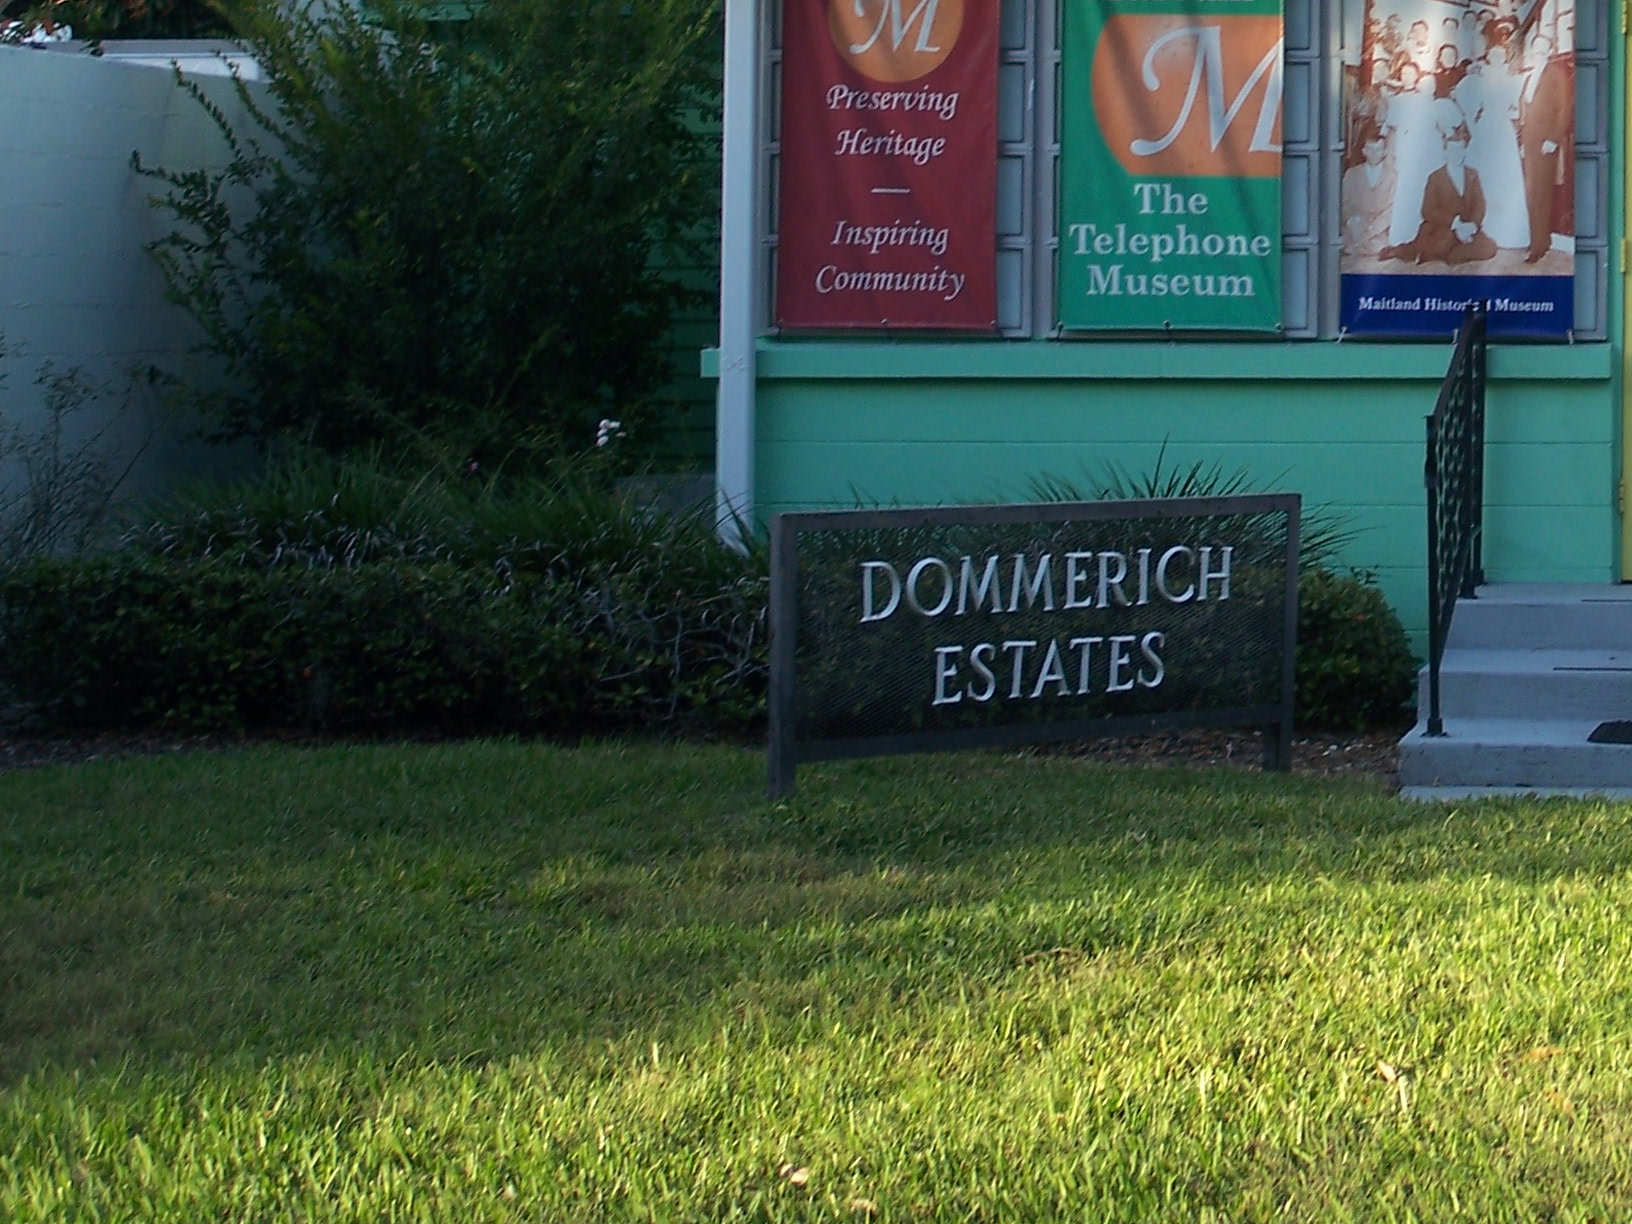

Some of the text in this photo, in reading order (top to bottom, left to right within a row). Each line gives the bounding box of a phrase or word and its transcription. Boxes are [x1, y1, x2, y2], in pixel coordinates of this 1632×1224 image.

[825, 84, 959, 121] Preserving
[834, 128, 946, 165] Heritage
[1134, 184, 1209, 215] The
[831, 219, 949, 256] Inspiring
[1069, 225, 1272, 262] Telephone
[815, 265, 965, 302] Community
[1087, 265, 1255, 297] Museum
[1358, 296, 1554, 313] Maitland Historcl Museum
[860, 545, 1234, 623] DOMMERICH
[932, 630, 1166, 706] ESTATES
